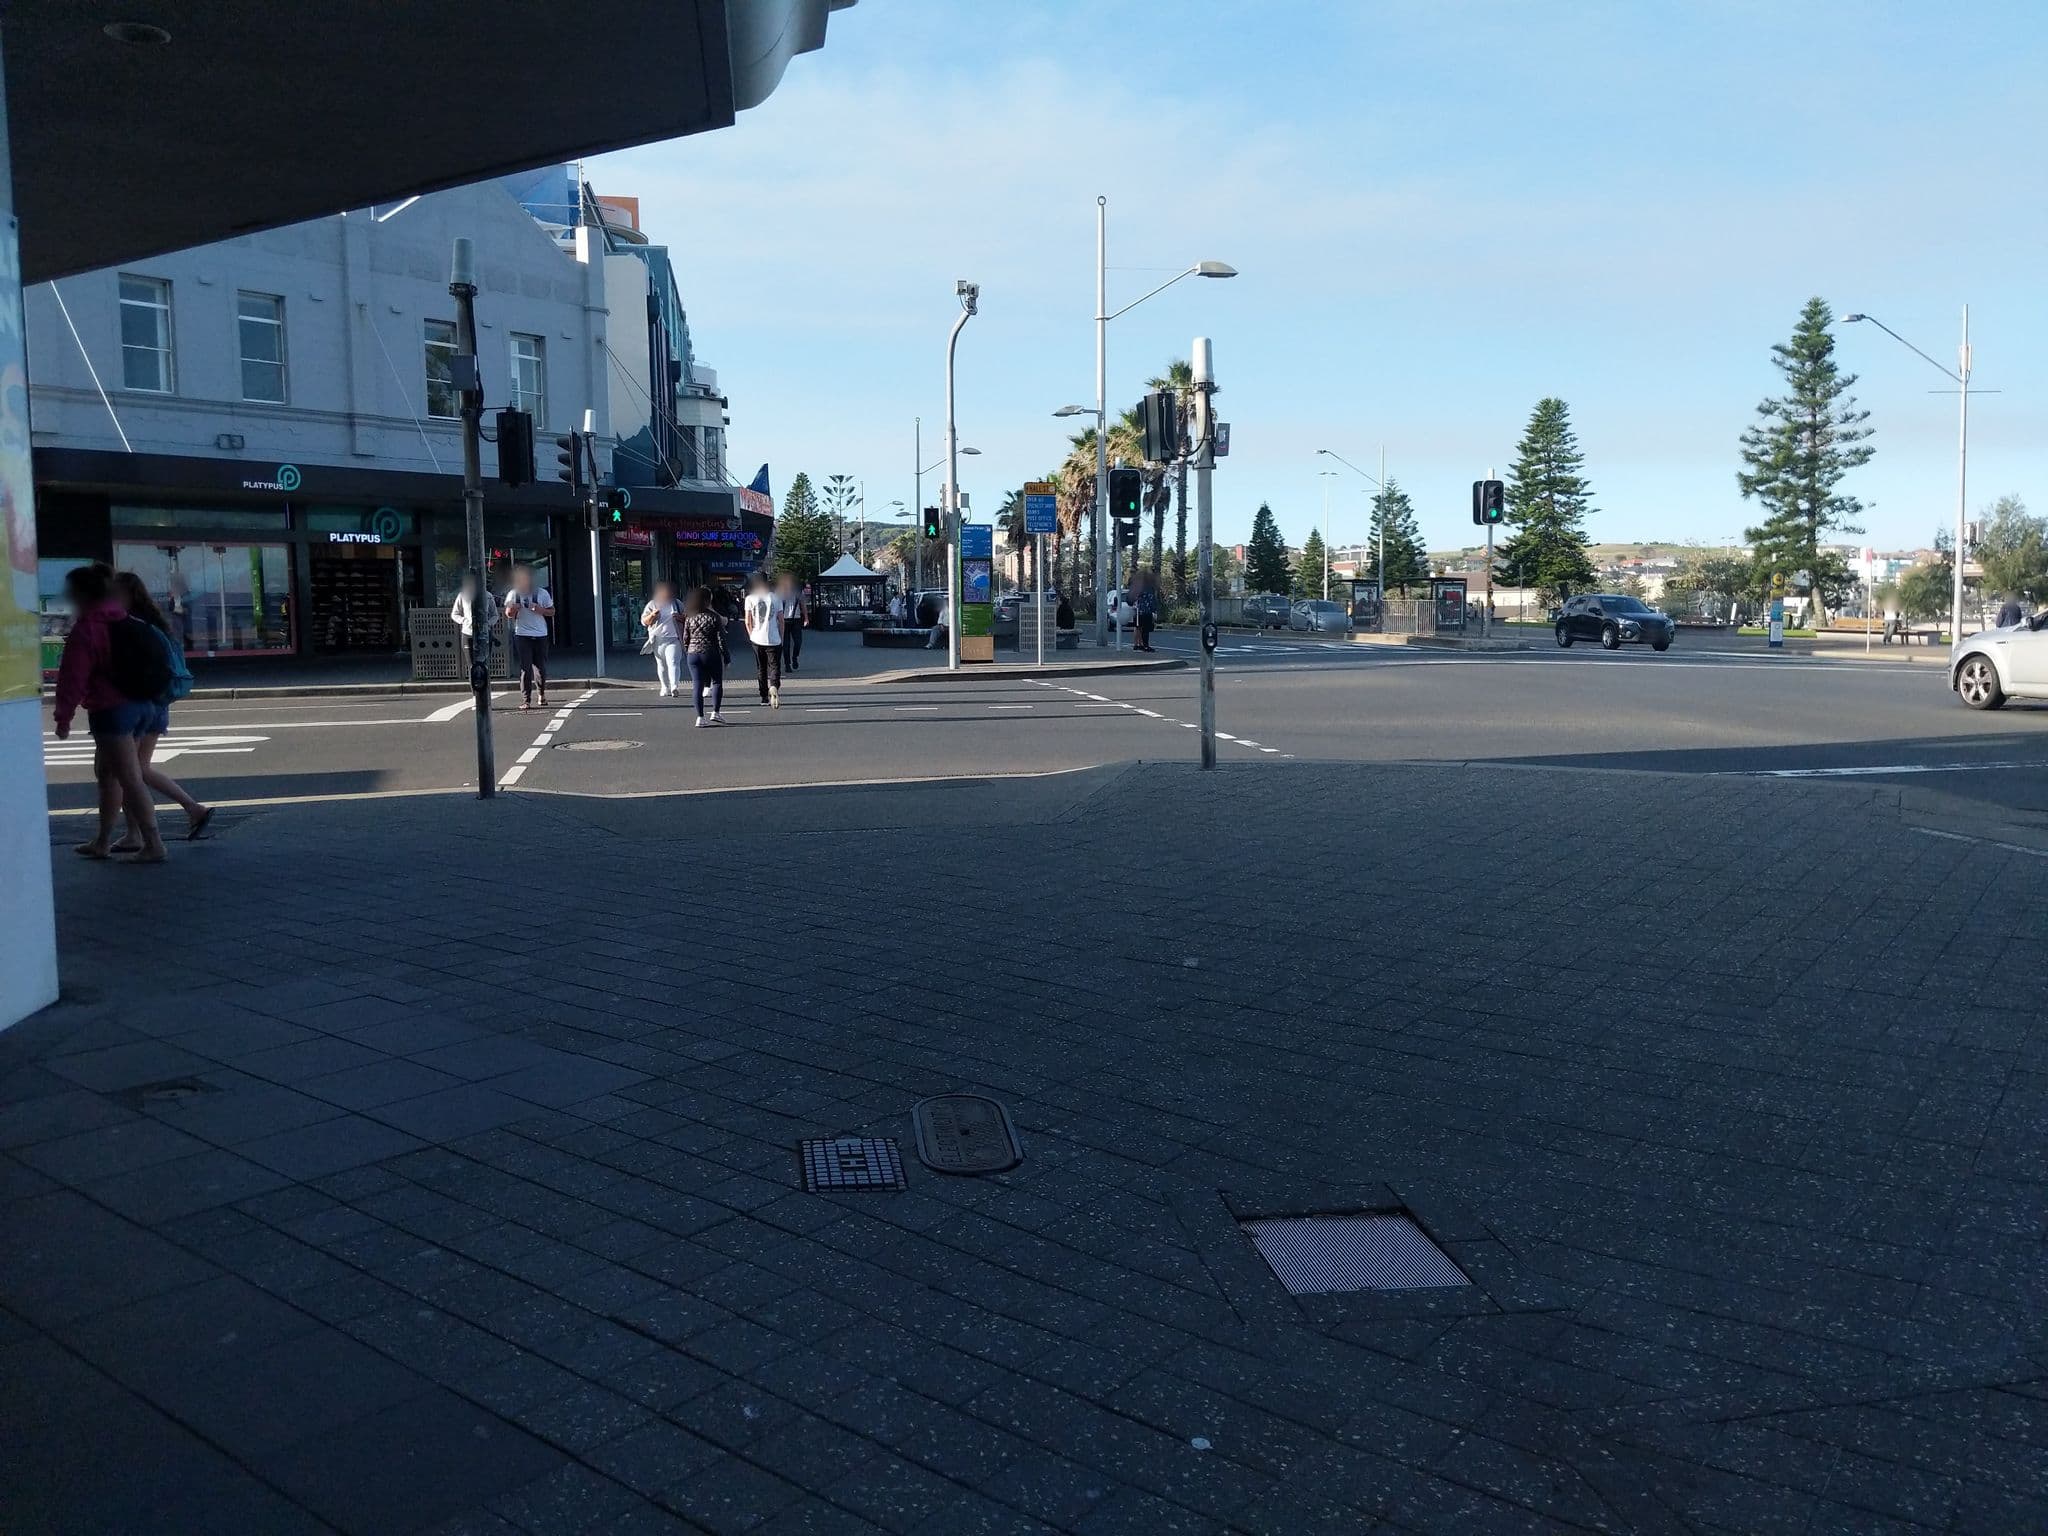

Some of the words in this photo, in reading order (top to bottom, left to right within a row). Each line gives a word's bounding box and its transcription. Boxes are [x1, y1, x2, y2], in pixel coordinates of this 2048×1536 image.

[243, 480, 284, 490] PLATYPUS
[330, 532, 381, 543] PLATYPUS
[676, 531, 700, 540] BONDI
[702, 531, 719, 540] SURF
[721, 531, 758, 541] SEAFOODS
